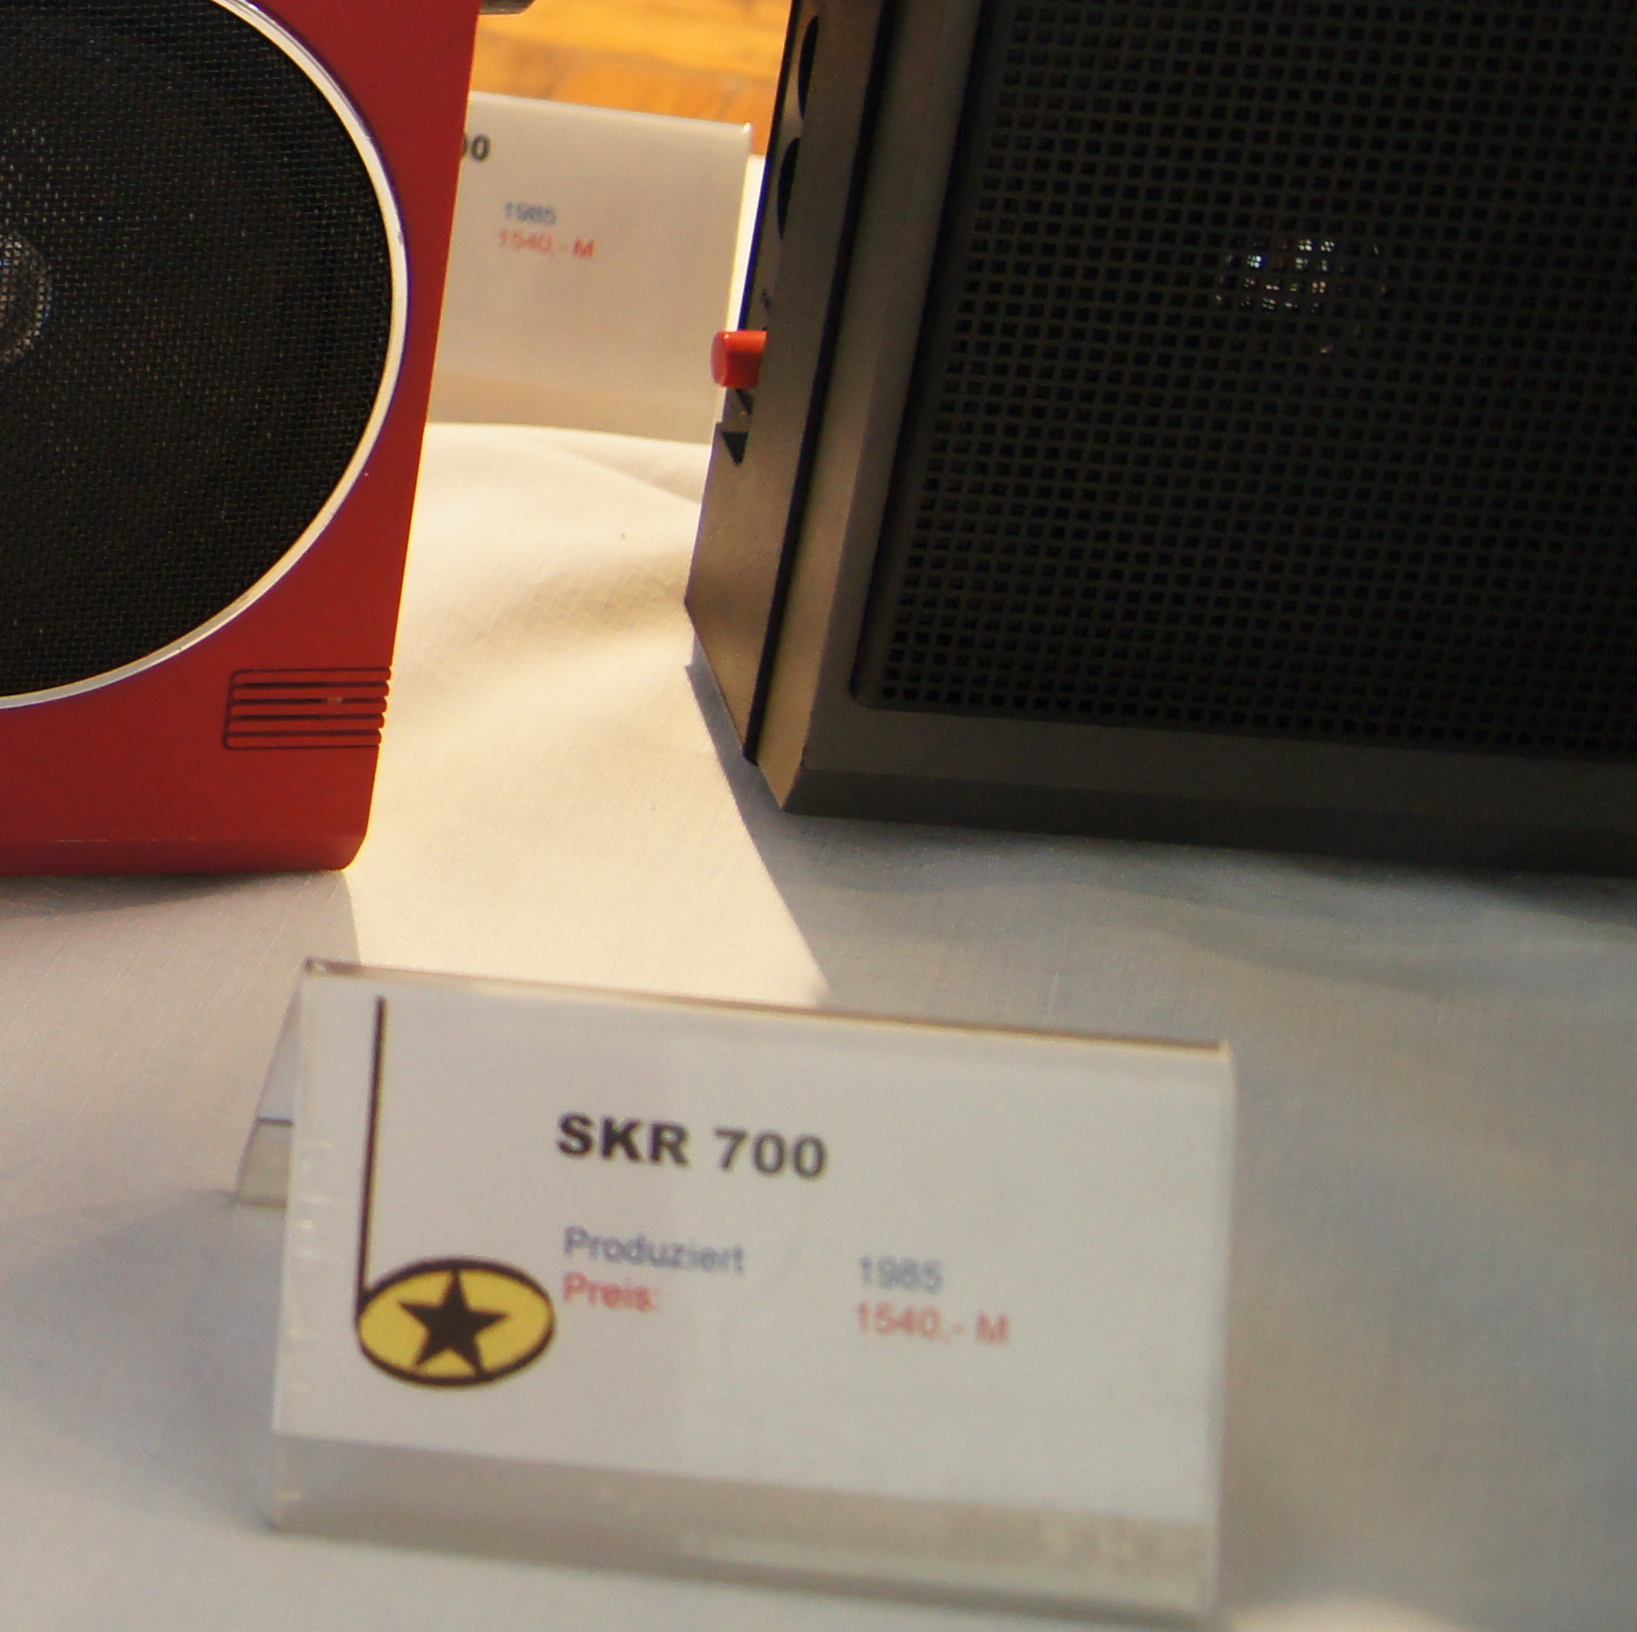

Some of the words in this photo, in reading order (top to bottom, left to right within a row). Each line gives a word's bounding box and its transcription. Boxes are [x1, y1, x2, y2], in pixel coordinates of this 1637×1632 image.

[557, 1113, 690, 1167] SKR
[715, 1127, 827, 1179] 700
[563, 1225, 745, 1276] Produziert
[859, 1253, 944, 1295] 1985
[974, 1312, 1011, 1346] M
